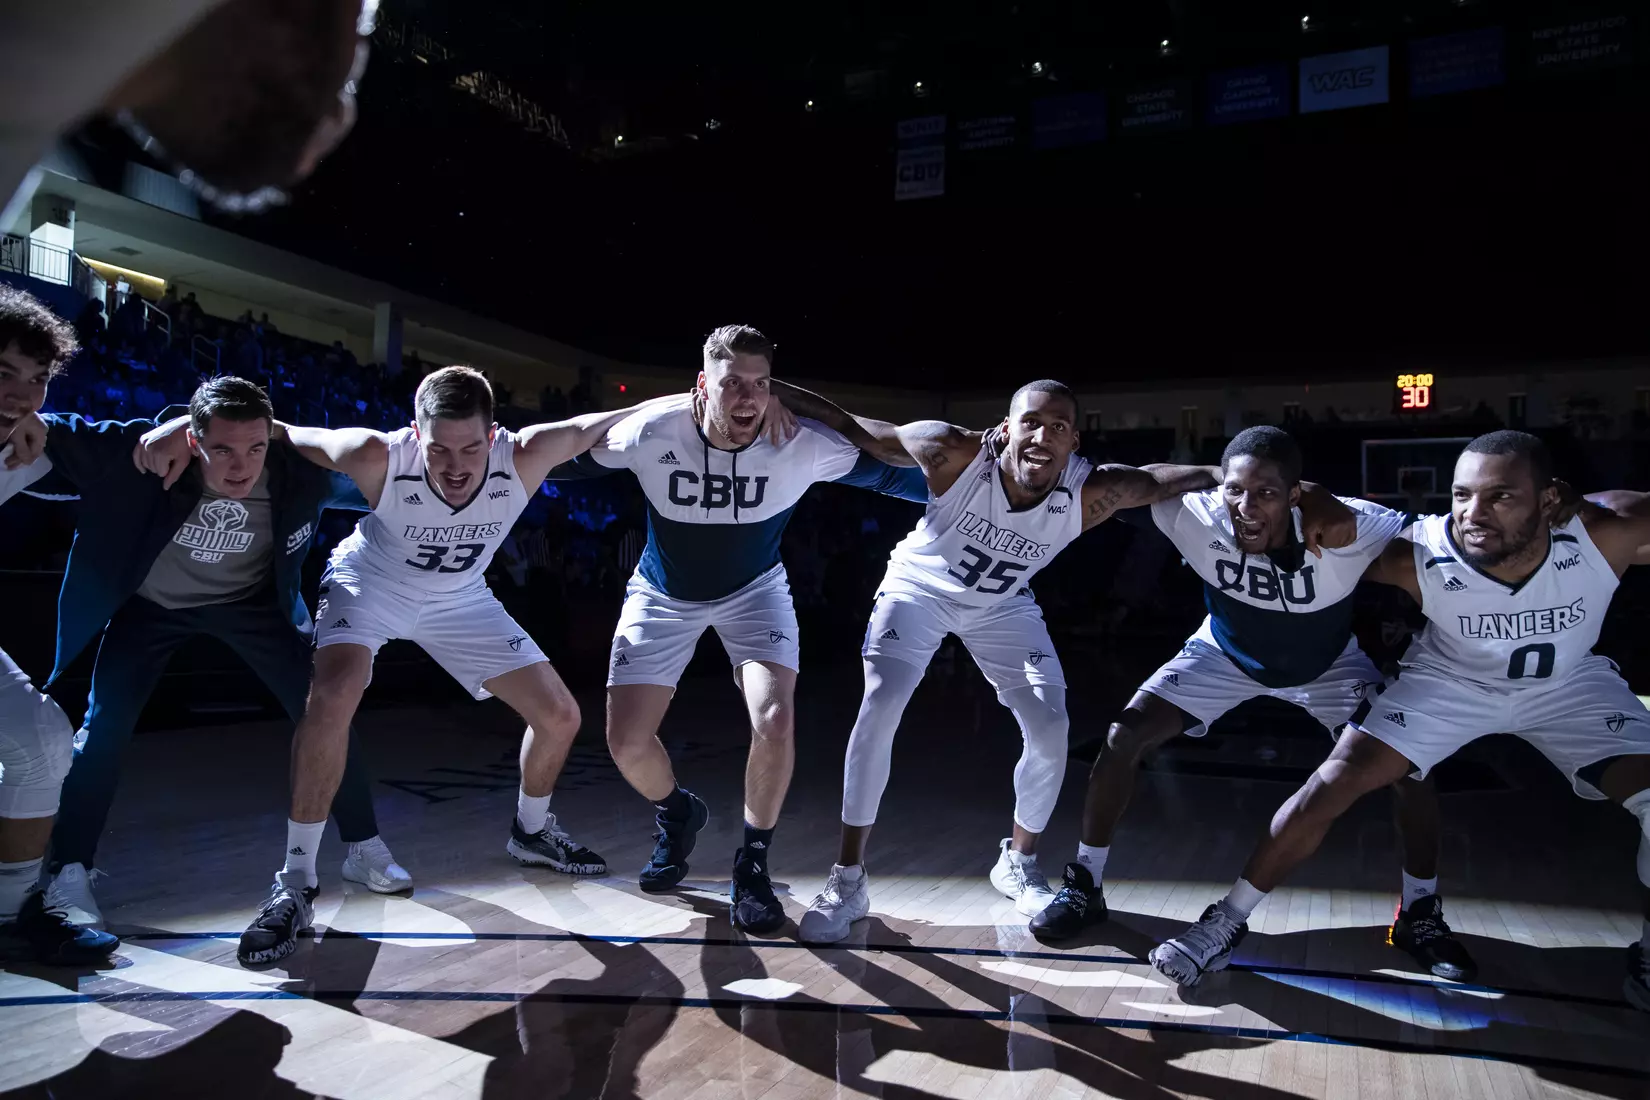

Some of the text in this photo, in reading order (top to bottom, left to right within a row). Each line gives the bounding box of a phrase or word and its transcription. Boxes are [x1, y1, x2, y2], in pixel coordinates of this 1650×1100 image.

[1308, 66, 1376, 94] WAC
[1397, 373, 1433, 388] 20:00
[1402, 386, 1429, 408] 30
[658, 458, 680, 466] adidas
[488, 490, 510, 500] WAC
[668, 470, 769, 509] CBU
[1048, 504, 1067, 515] WAC
[287, 521, 311, 548] CBU
[404, 522, 502, 542] LANCERS
[956, 511, 1051, 561] LANCERS
[190, 550, 225, 561] CBU
[405, 543, 486, 573] 33
[1554, 554, 1580, 571] WAC
[948, 544, 1028, 594] 35
[1215, 559, 1316, 604] CBU
[1443, 584, 1467, 592] adidas
[1458, 597, 1586, 640] LANCERS
[1507, 643, 1556, 679] 0
